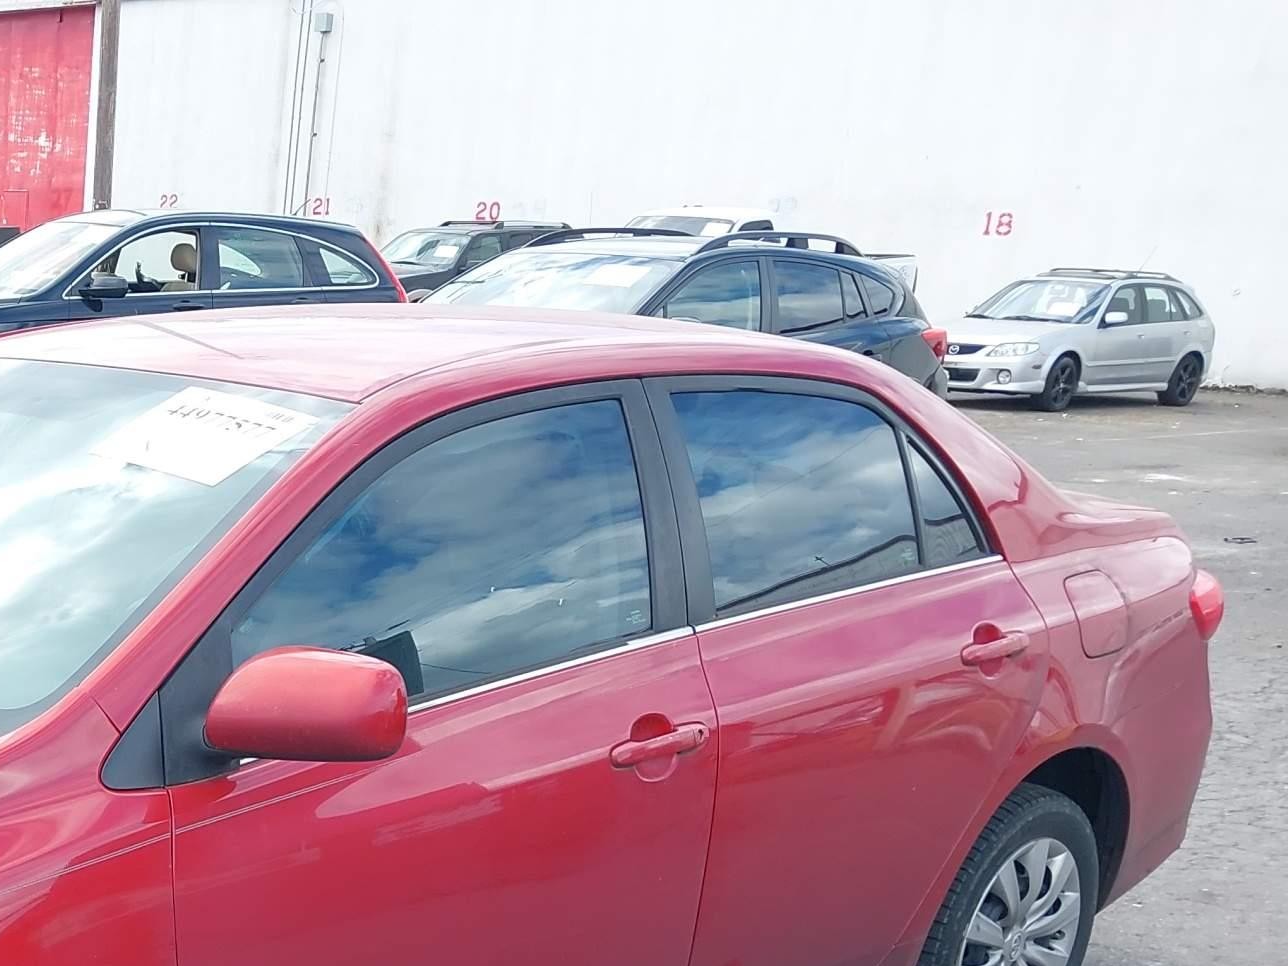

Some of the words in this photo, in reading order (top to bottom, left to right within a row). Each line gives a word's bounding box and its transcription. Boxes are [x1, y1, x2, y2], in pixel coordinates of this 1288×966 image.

[160, 194, 178, 208] 22
[312, 198, 331, 215] 21
[475, 202, 501, 221] 20
[983, 212, 1014, 237] 18
